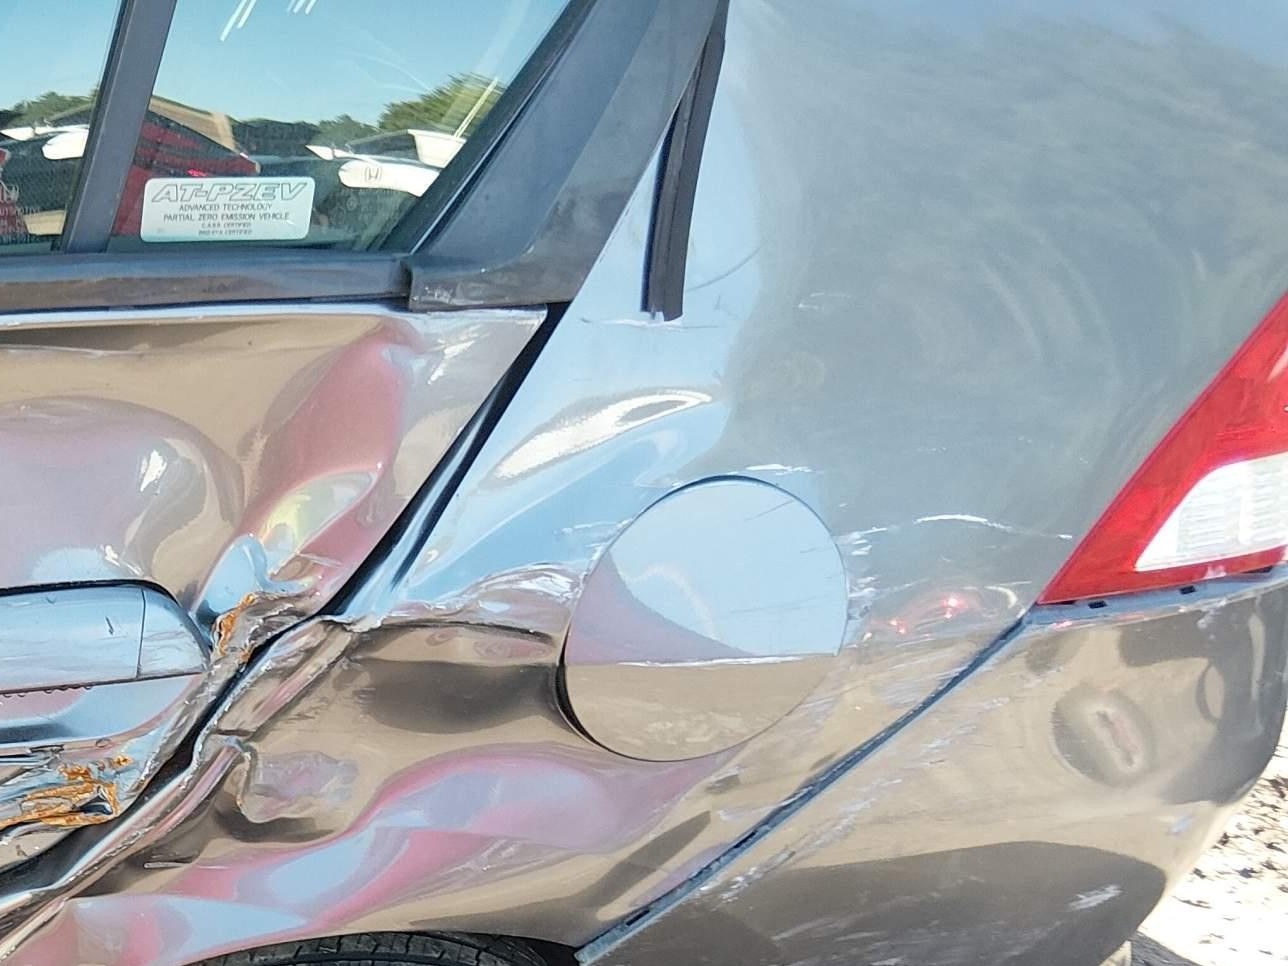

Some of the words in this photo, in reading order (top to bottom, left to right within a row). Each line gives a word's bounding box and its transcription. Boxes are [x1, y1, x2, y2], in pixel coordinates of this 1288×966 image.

[151, 181, 308, 203] AT-PZEV
[179, 203, 220, 212] ADVANCED
[223, 202, 273, 212] TECHNOLOGY
[163, 213, 195, 222] PARTIAL
[198, 213, 218, 221] ZERO
[221, 212, 256, 221] EMISSION
[259, 211, 290, 221] VEHICLE
